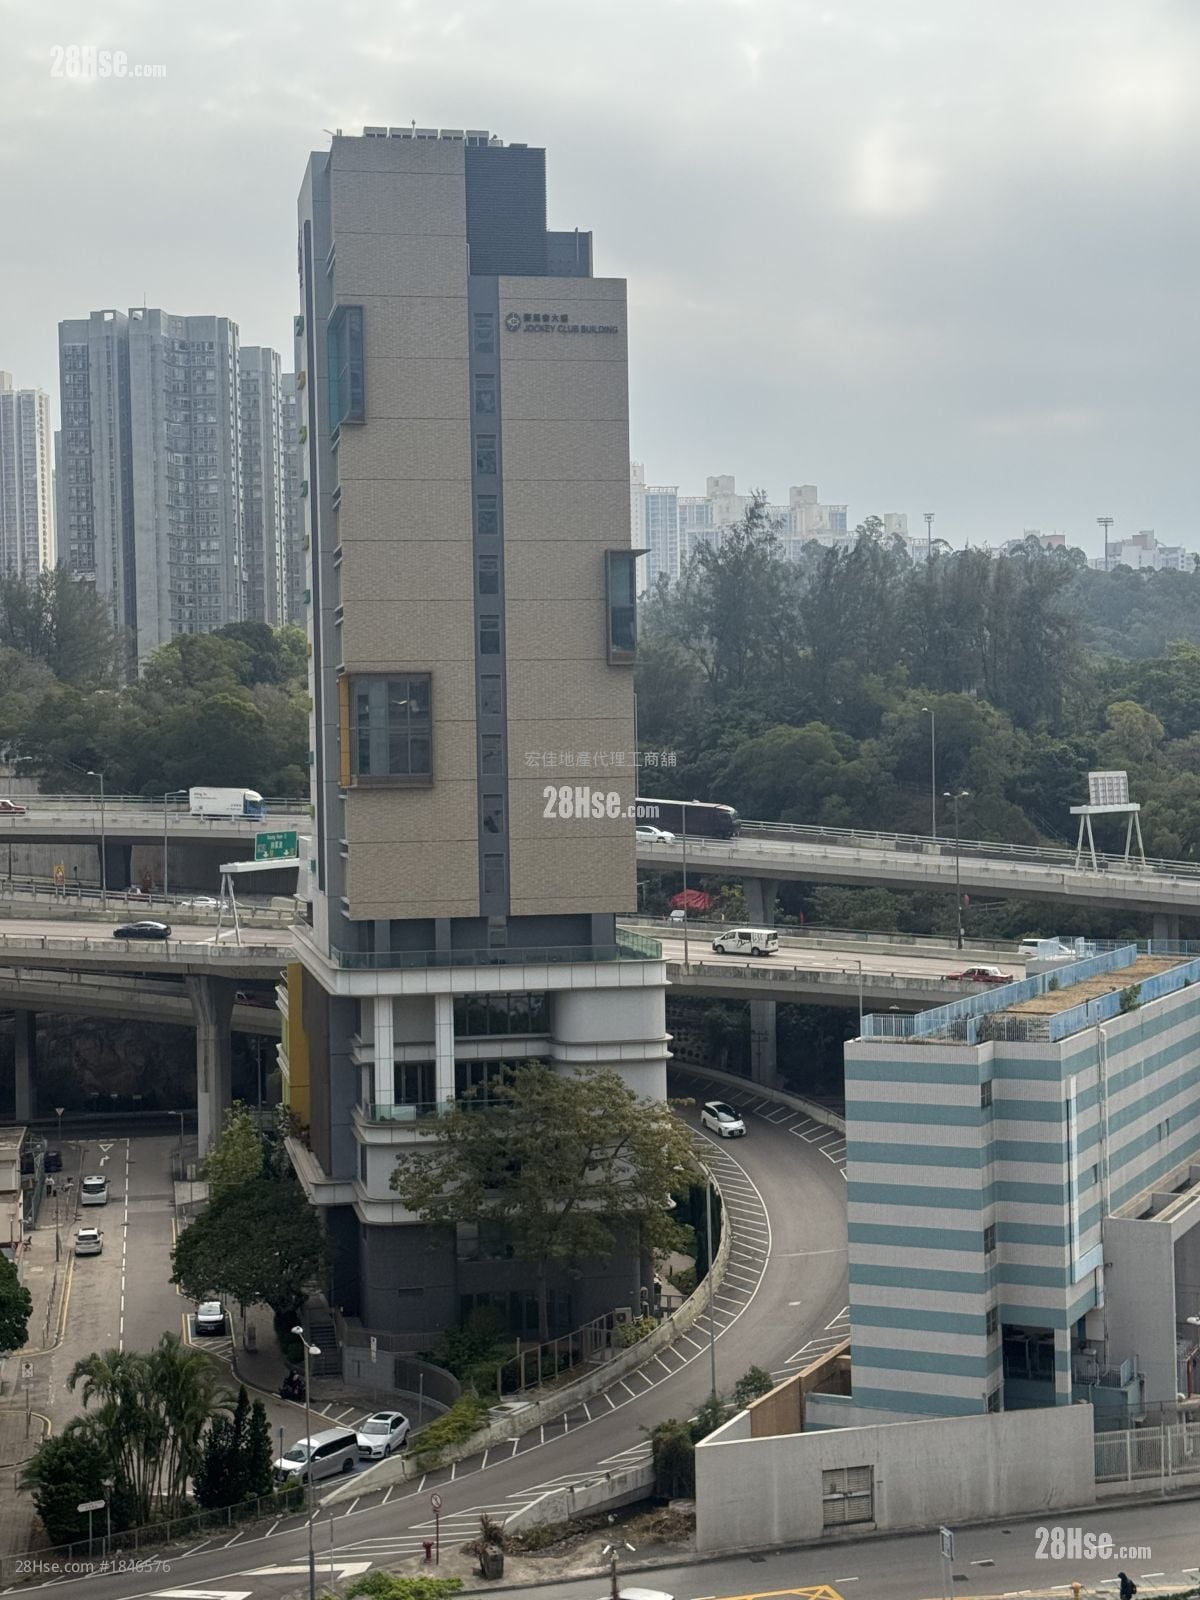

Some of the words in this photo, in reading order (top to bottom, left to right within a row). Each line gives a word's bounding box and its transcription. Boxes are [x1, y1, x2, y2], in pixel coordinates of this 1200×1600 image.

[523, 324, 556, 333] JOCKEY
[557, 325, 579, 333] CLUB
[581, 325, 619, 334] BUILDING
